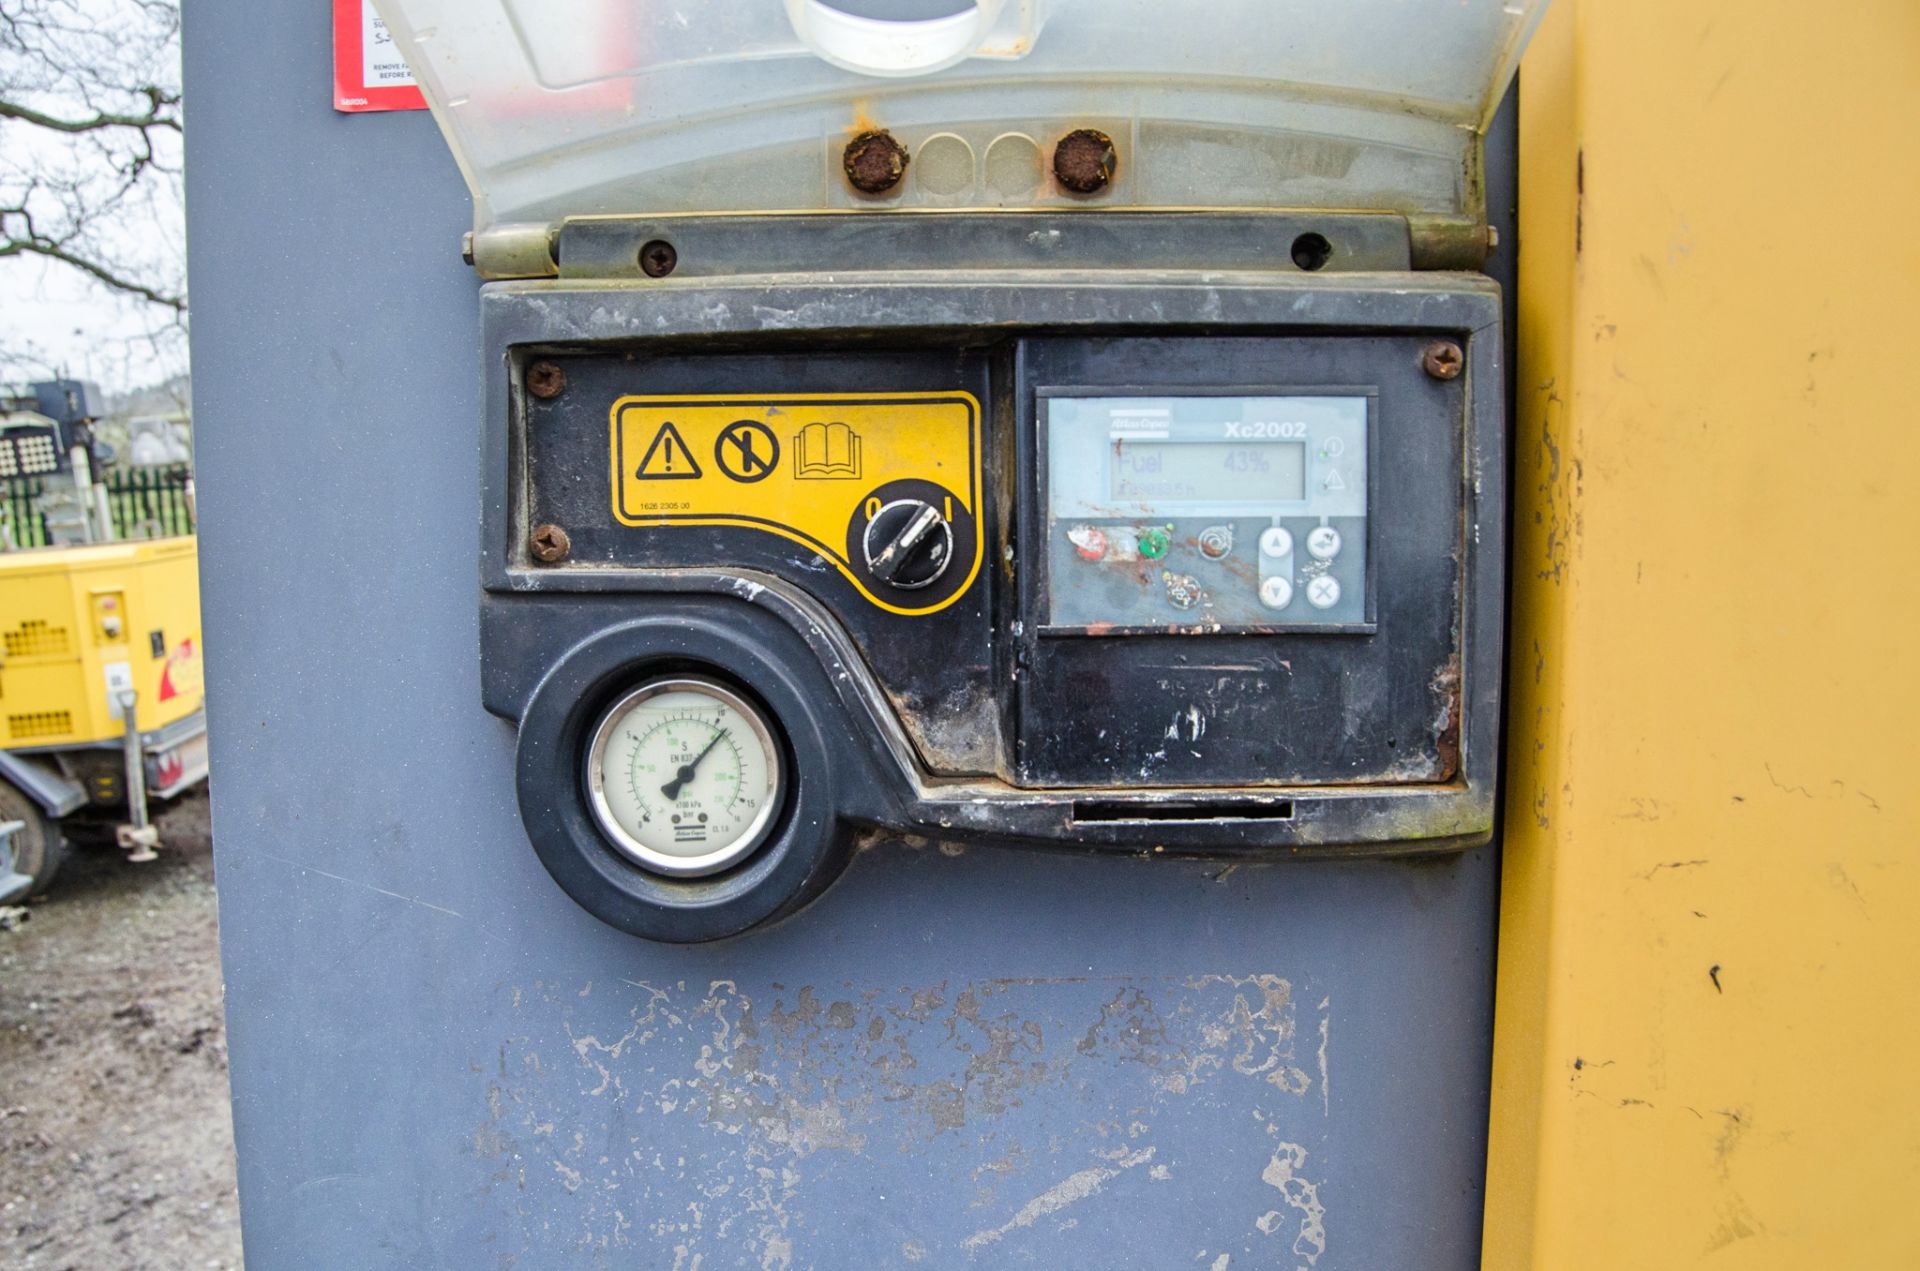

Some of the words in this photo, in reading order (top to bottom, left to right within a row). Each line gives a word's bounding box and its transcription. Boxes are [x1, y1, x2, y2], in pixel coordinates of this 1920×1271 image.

[379, 71, 405, 79] BEFORE
[1224, 421, 1308, 438] Xc2002
[1117, 448, 1163, 473] Fuel
[1223, 450, 1270, 473] 43%
